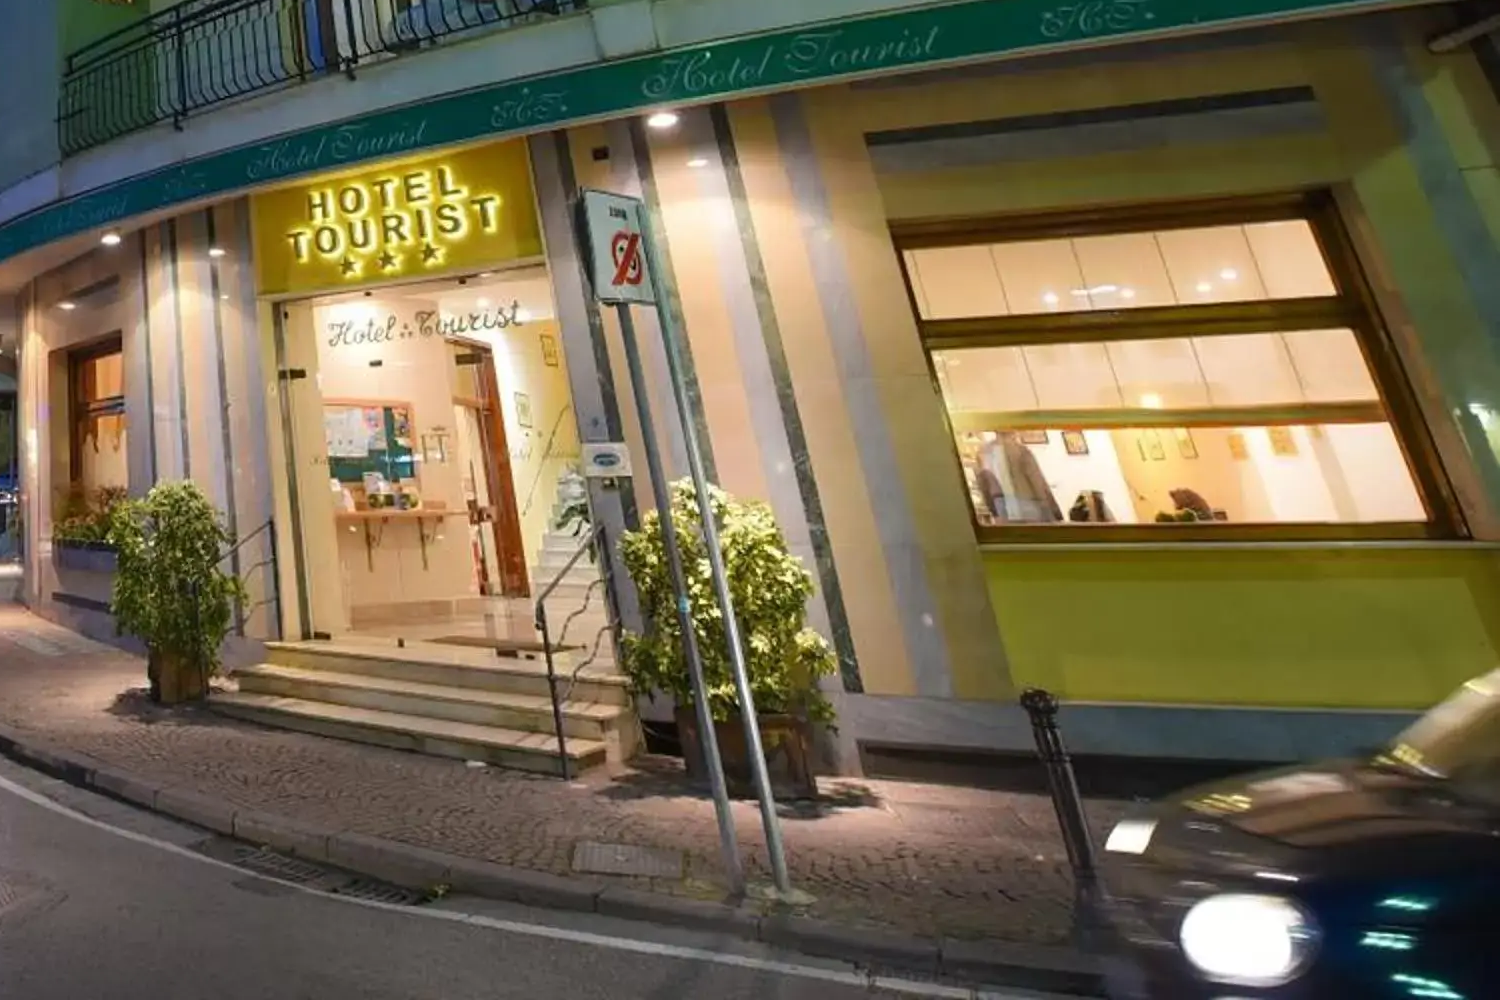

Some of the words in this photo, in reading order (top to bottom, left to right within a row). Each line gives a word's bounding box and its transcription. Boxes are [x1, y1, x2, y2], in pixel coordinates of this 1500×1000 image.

[641, 45, 773, 98] Hotel
[783, 25, 939, 74] Tourist
[246, 134, 326, 179] Hotel
[331, 119, 428, 159] Tourist
[308, 166, 465, 222] HOTEL
[286, 195, 498, 261] TOURIST
[327, 314, 397, 348] Hotel
[414, 299, 523, 338] Tourist
